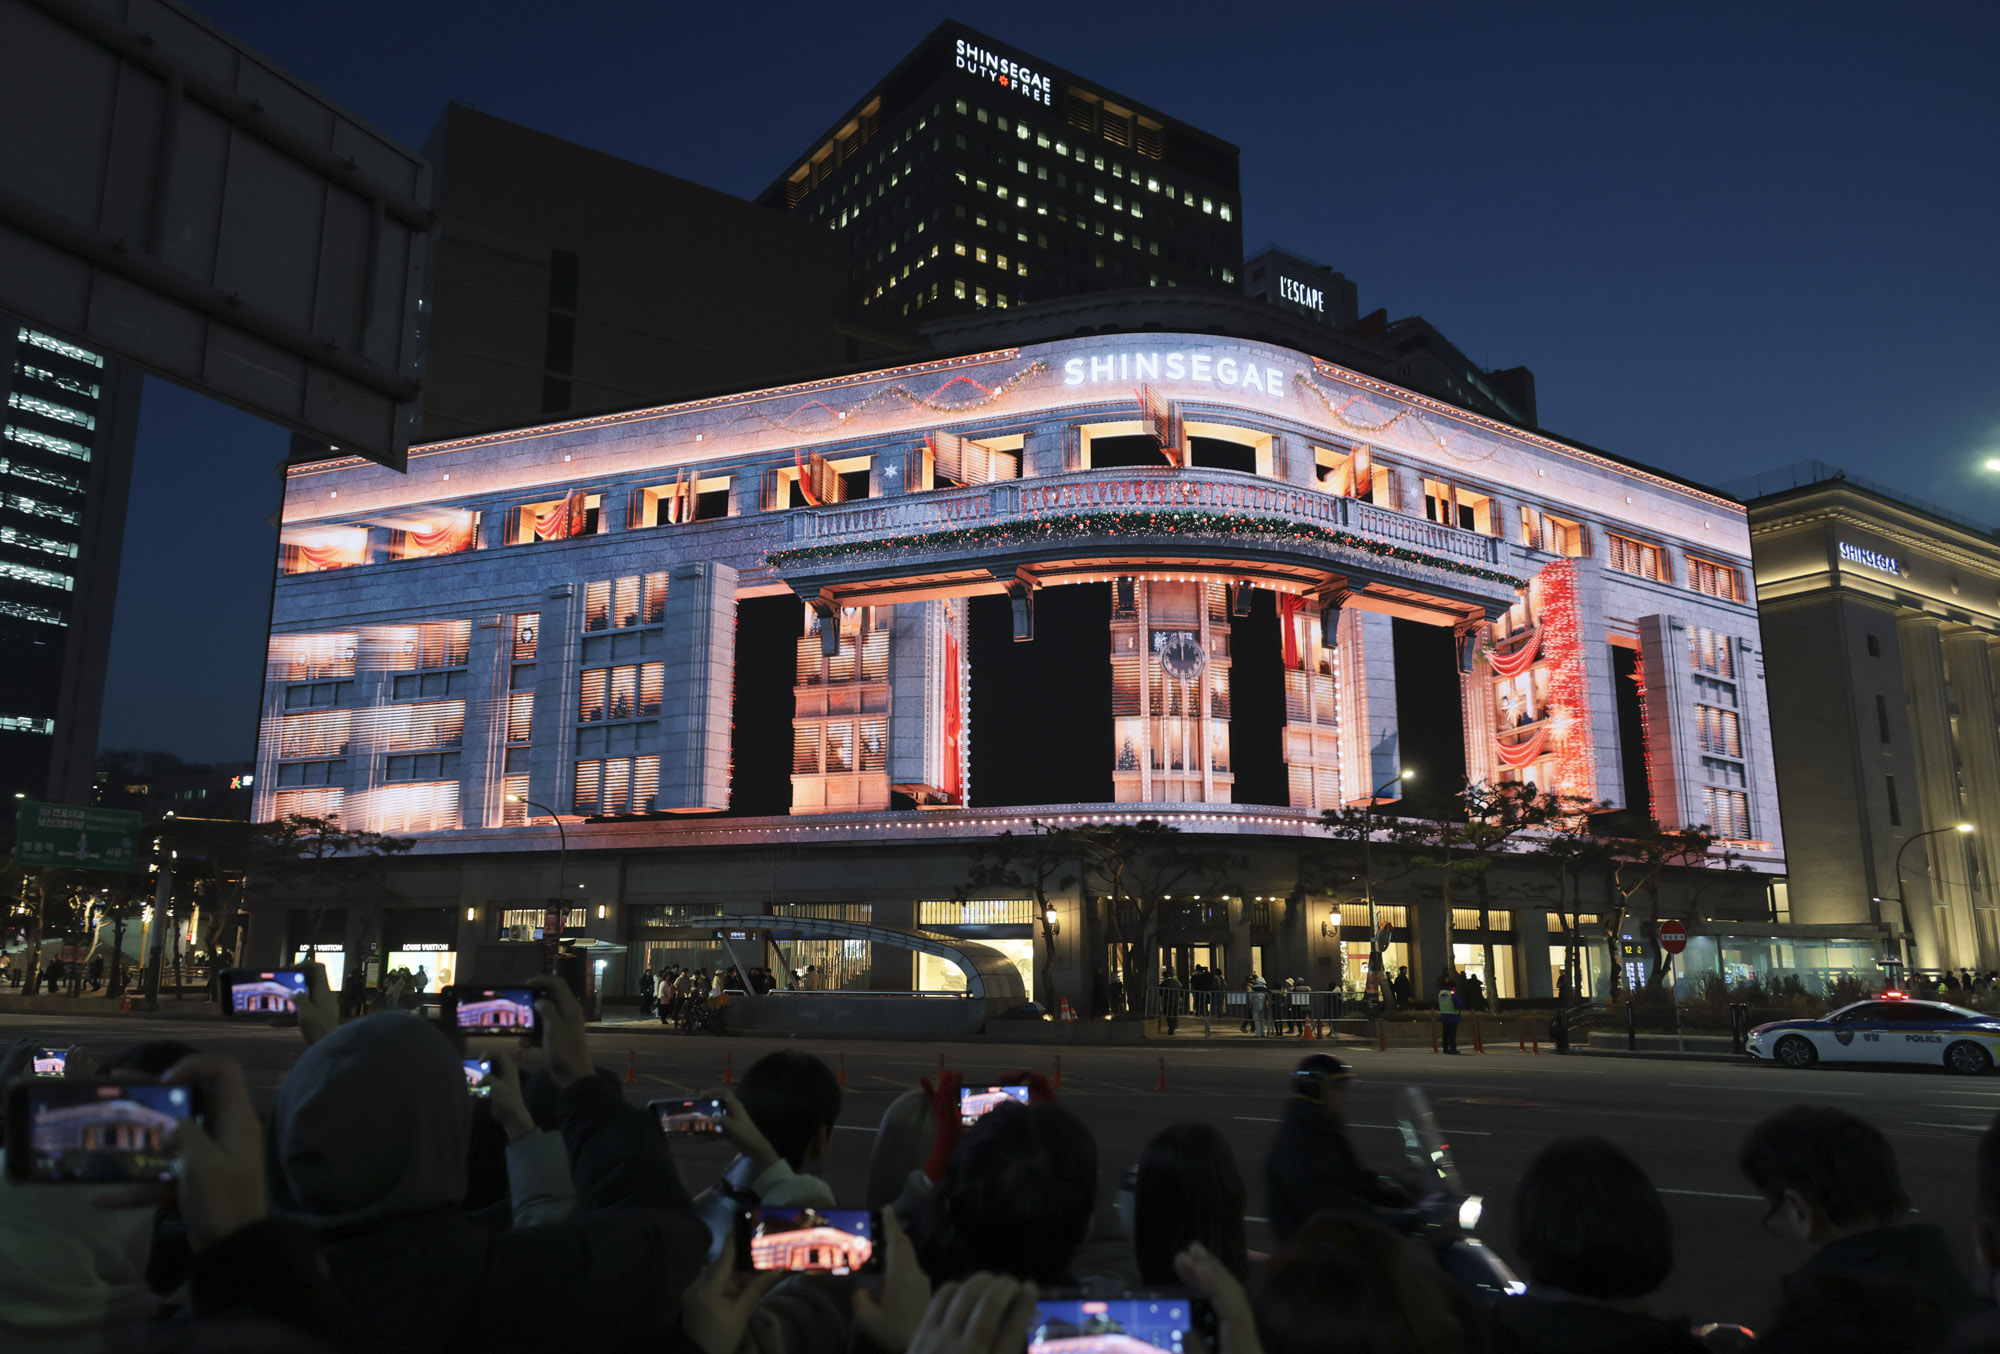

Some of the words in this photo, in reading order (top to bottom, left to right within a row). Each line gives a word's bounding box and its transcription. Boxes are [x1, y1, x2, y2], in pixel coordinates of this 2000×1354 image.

[956, 39, 1051, 93] SHINSEGAE
[956, 55, 998, 82] DUTY
[1011, 79, 1051, 106] FREE
[1280, 275, 1324, 313] L'ESCAPE
[1063, 351, 1285, 397] SHINSEGAE
[1839, 541, 1900, 576] SHINSEGAE
[52, 807, 86, 820] 반포대교
[318, 944, 343, 952] VUITTON
[402, 943, 421, 951] LOUIS
[421, 943, 449, 951] VUITTON
[1863, 1033, 1880, 1042] 경찰
[1905, 1034, 1943, 1044] POLICE
